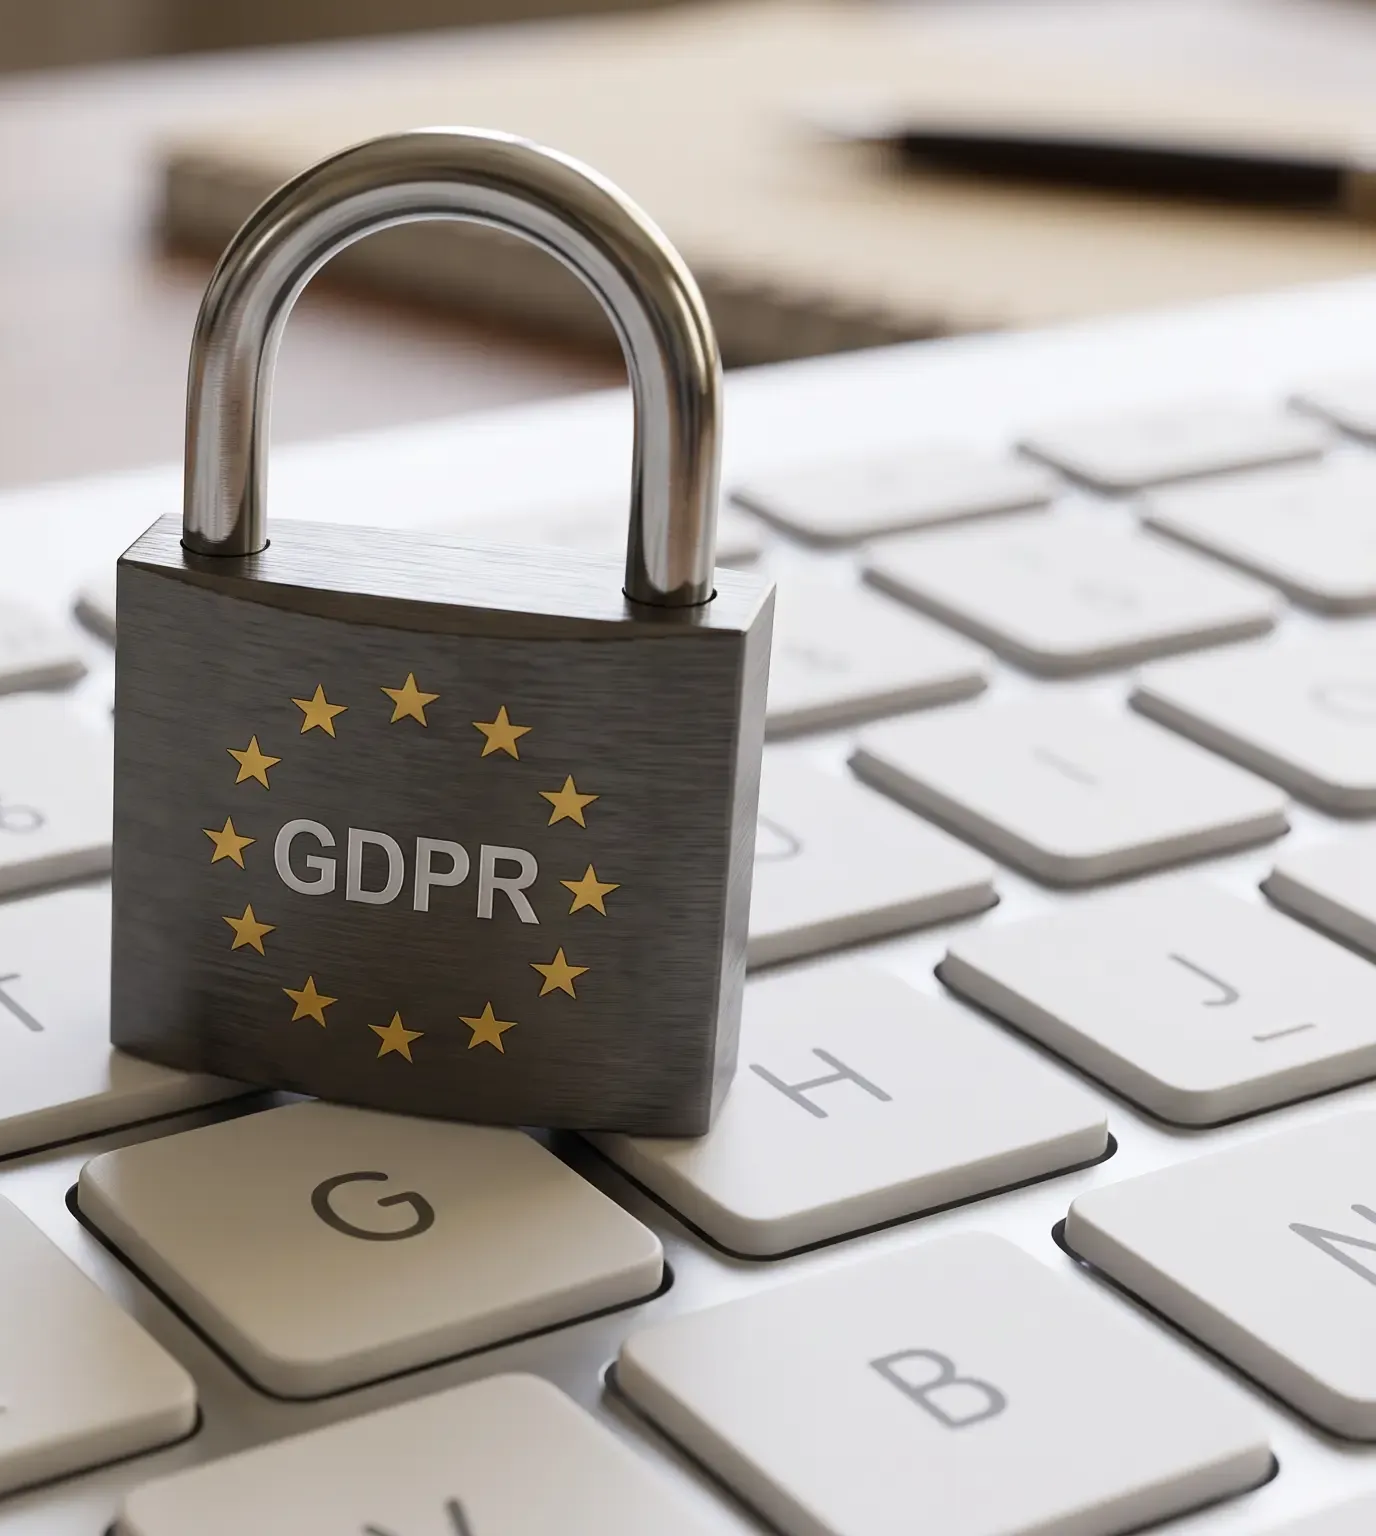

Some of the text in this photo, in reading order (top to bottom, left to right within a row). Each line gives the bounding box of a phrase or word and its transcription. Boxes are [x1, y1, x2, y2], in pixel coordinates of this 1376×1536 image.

[273, 818, 540, 925] GDPR
[1167, 952, 1241, 1008] J
[748, 1047, 894, 1119] H
[310, 1170, 435, 1242] G
[867, 1348, 1009, 1432] B
